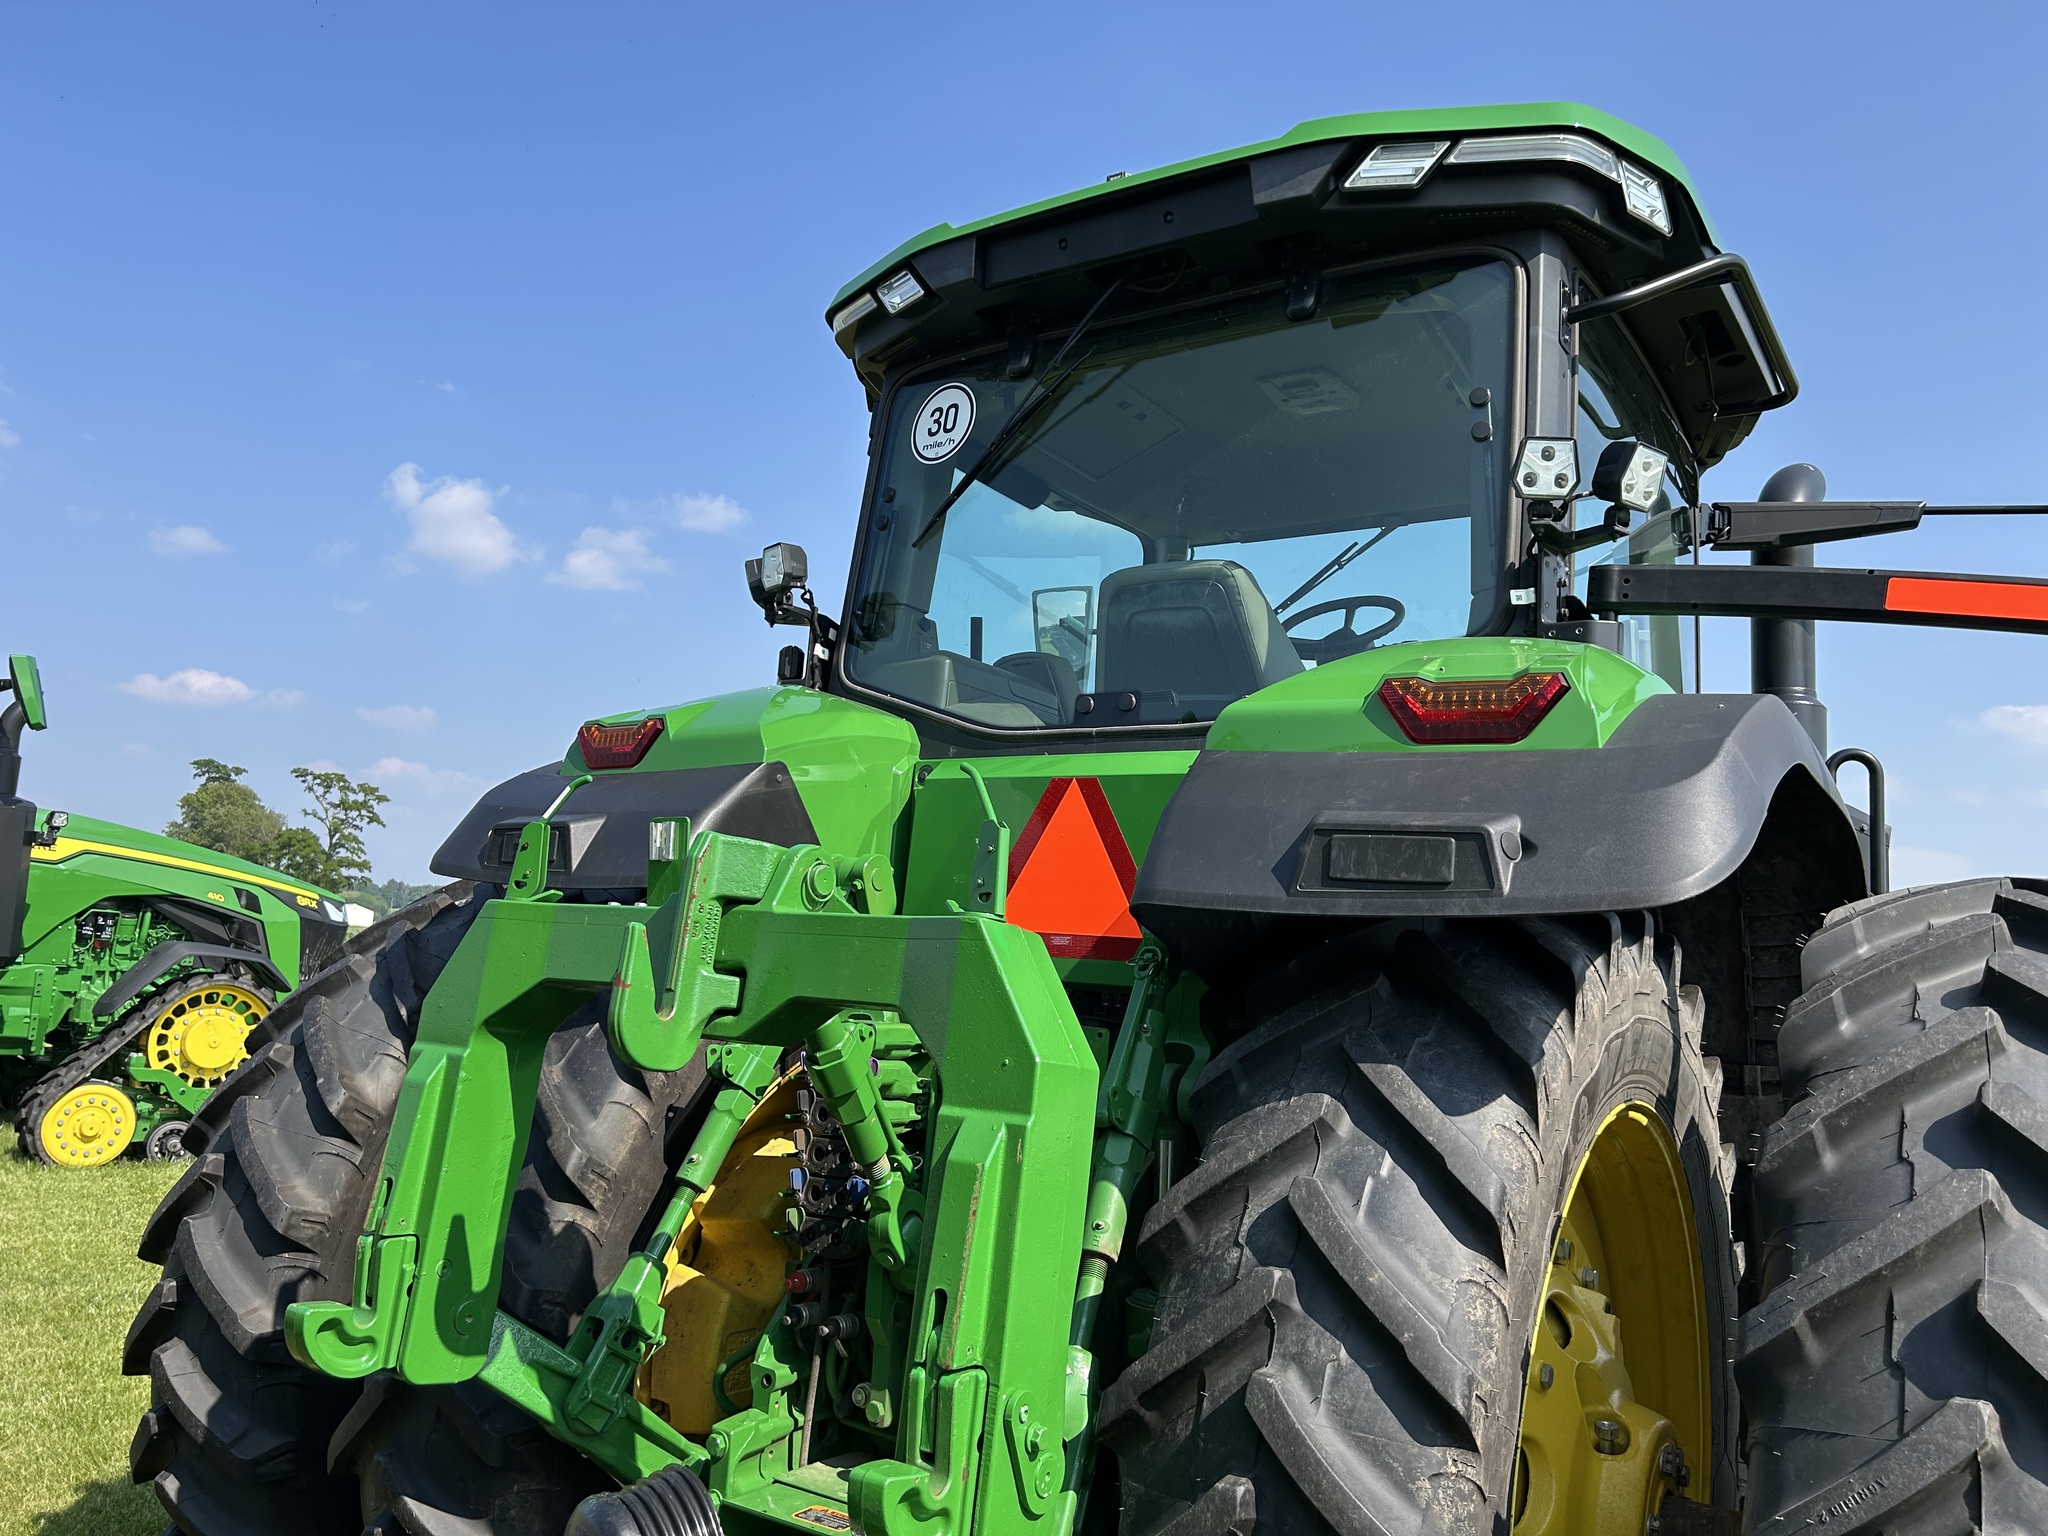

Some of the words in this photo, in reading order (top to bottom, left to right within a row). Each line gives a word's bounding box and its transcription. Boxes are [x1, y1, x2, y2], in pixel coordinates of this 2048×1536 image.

[927, 403, 959, 437] 30
[922, 437, 956, 451] mile/h
[207, 891, 225, 902] 410
[296, 895, 318, 909] 8RX
[1820, 1510, 1830, 1523] 2
